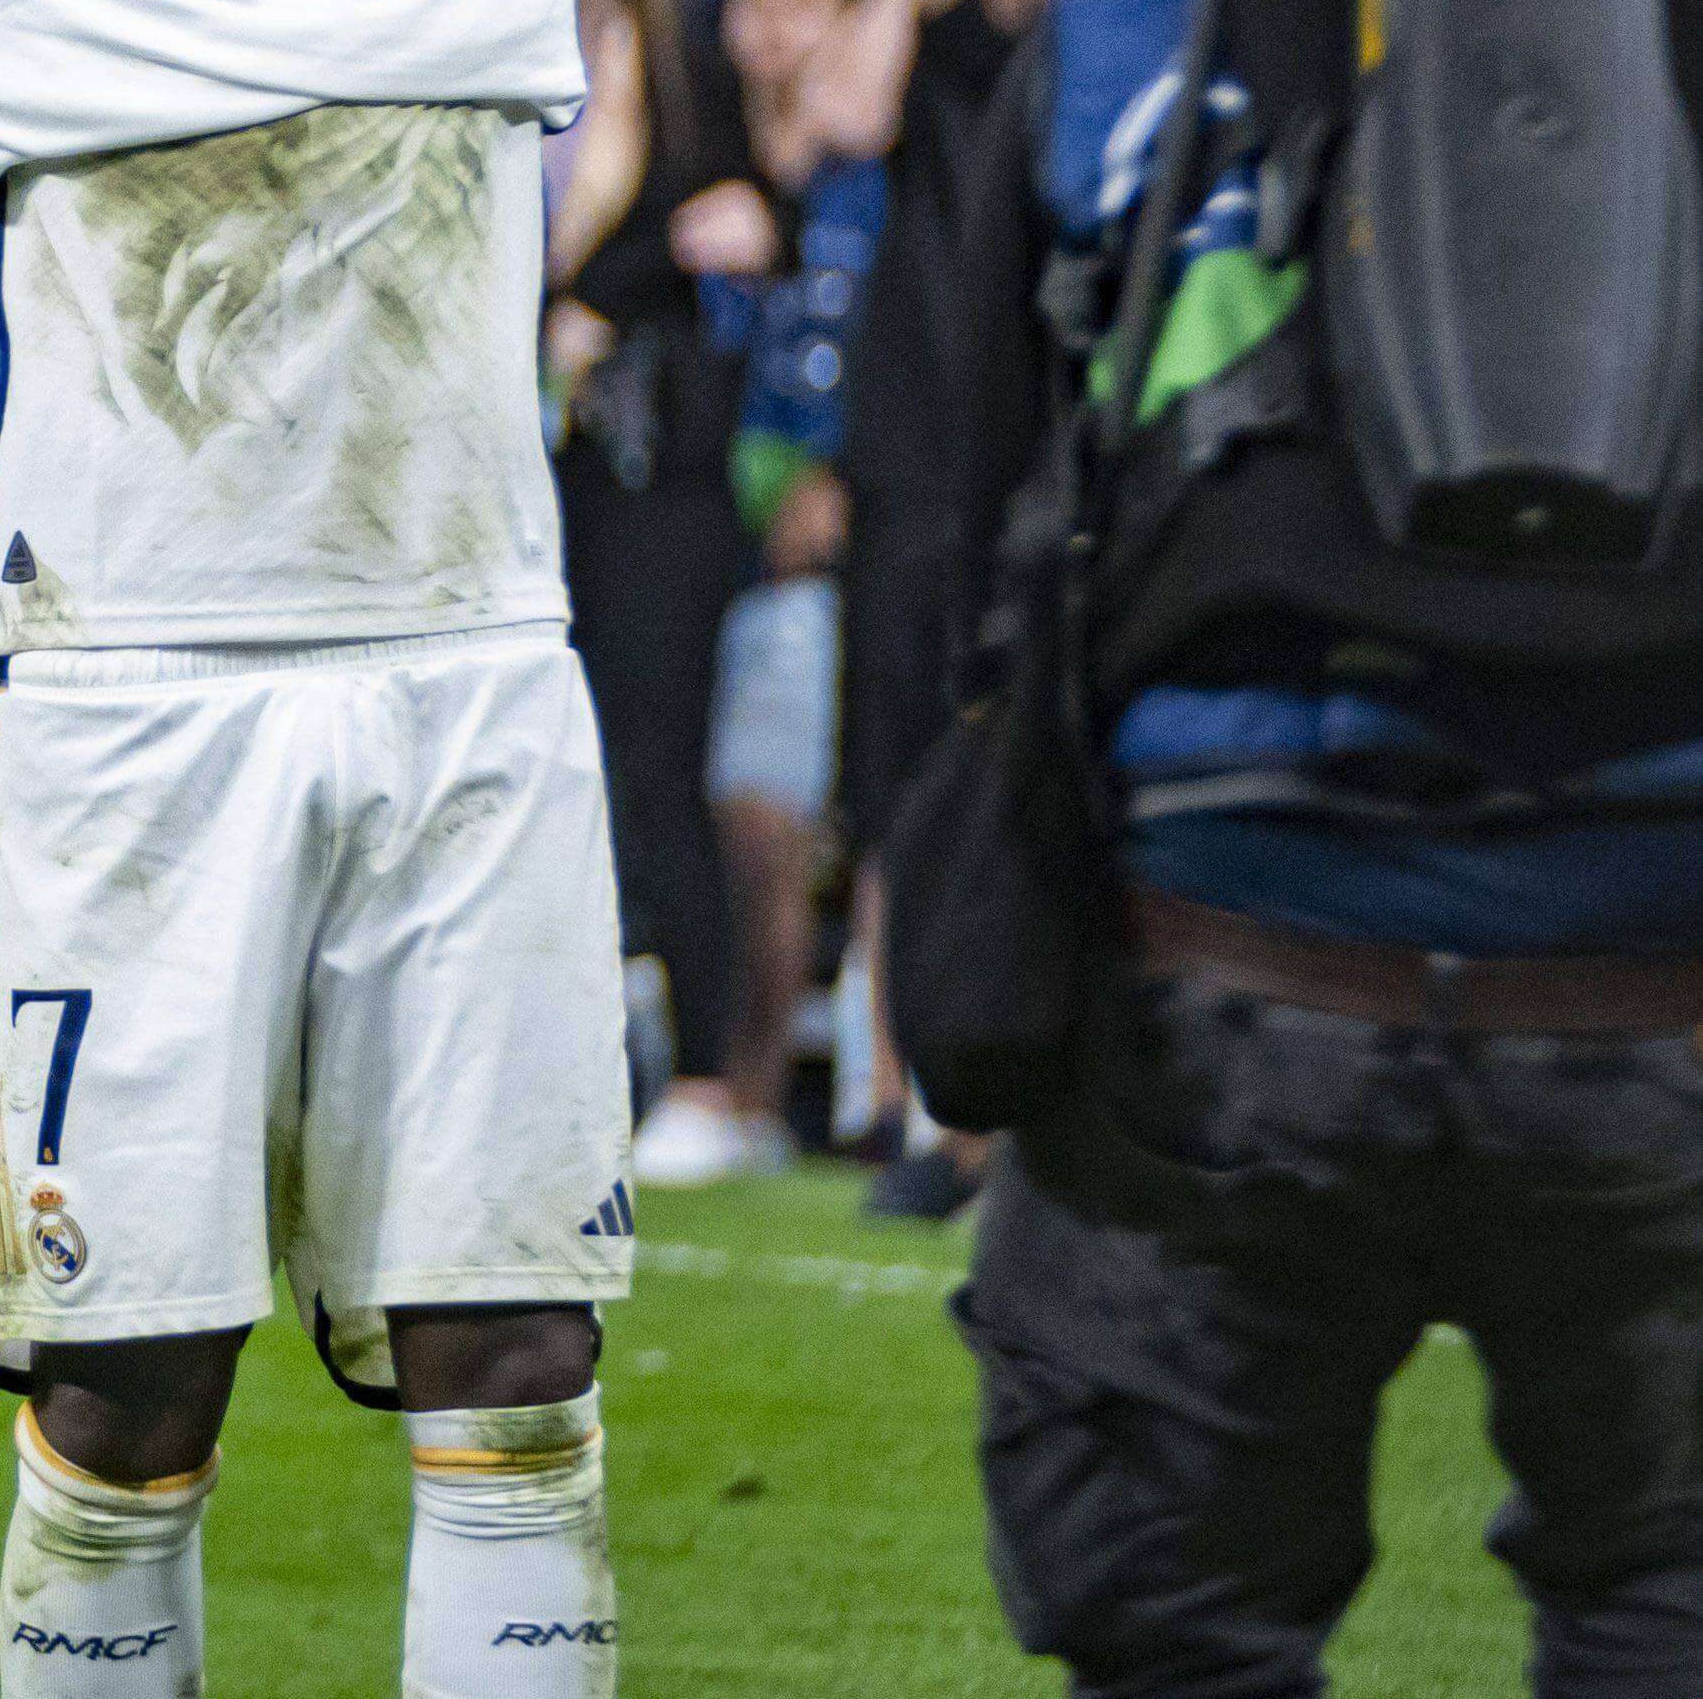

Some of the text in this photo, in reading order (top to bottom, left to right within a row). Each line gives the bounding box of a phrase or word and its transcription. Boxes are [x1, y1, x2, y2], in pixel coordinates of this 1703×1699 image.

[11, 988, 92, 1165] 7
[11, 1621, 179, 1661] RMCF
[490, 1619, 618, 1647] RMC
